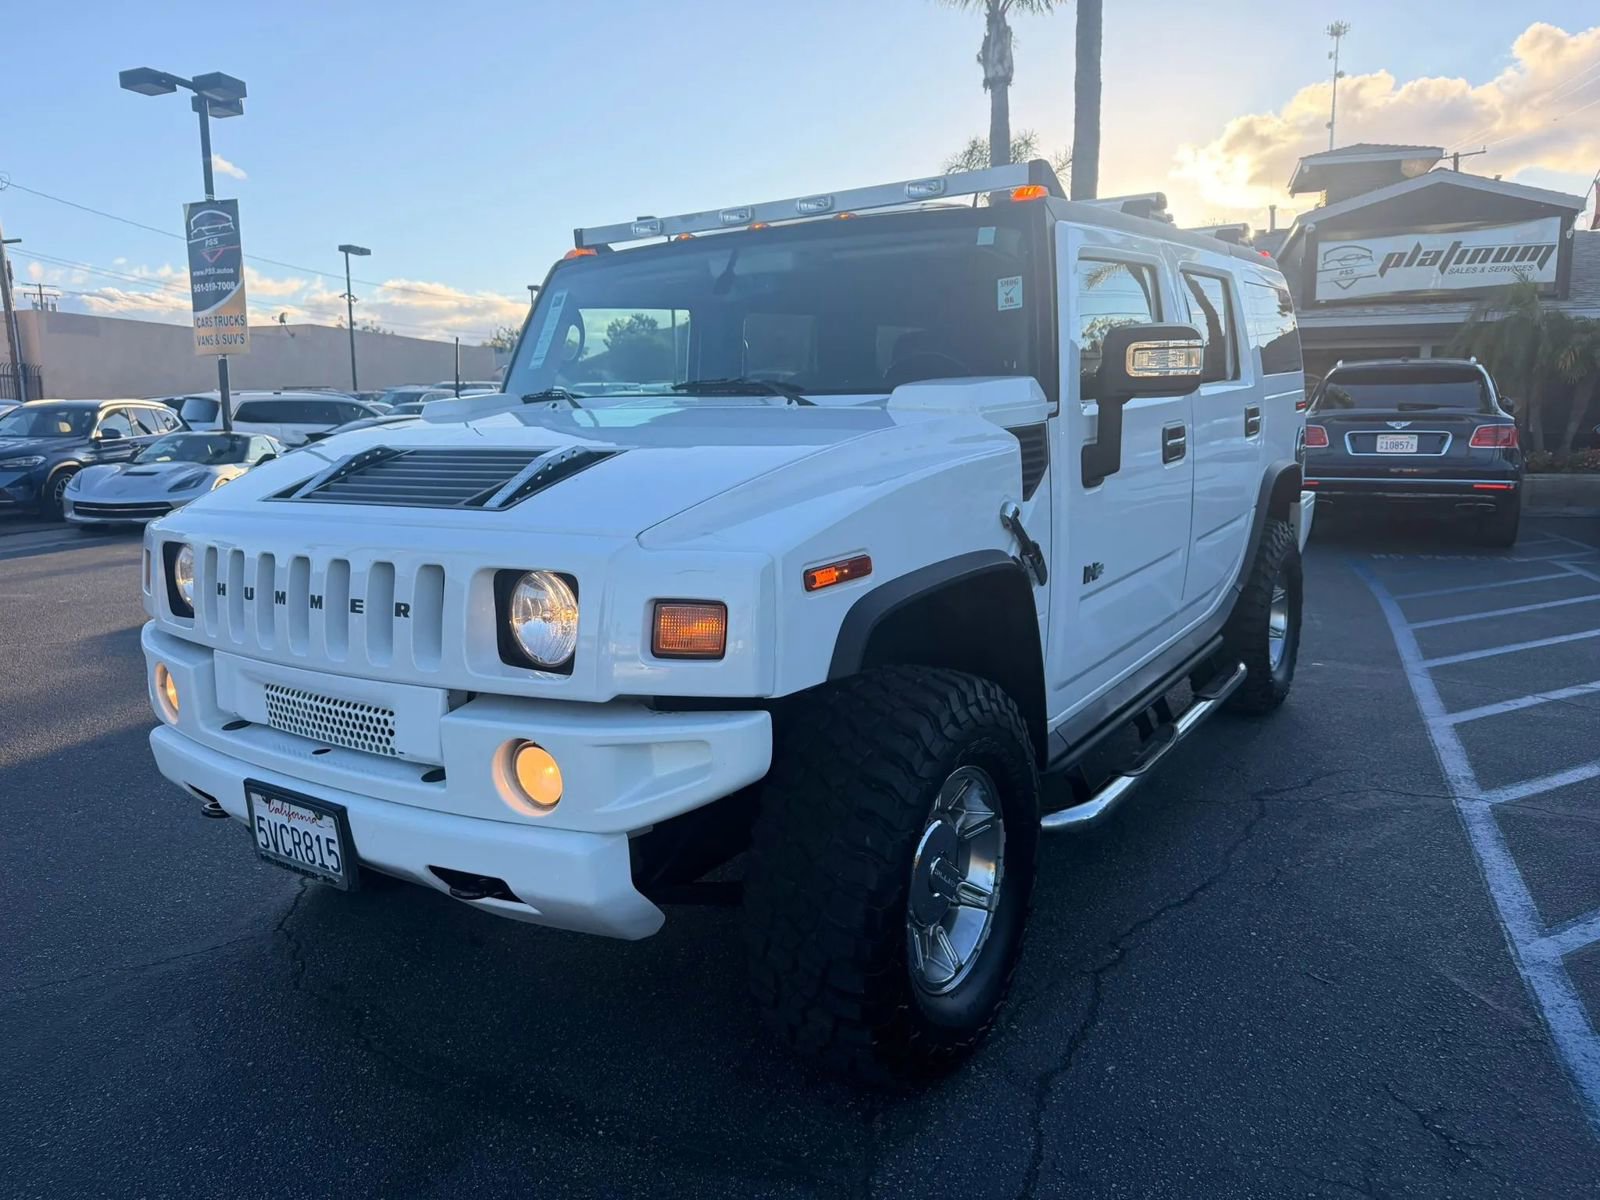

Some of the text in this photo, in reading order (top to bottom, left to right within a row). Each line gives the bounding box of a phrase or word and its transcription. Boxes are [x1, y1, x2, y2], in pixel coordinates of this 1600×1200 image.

[1448, 266, 1478, 275] SALES
[1488, 264, 1535, 273] SERVICES
[197, 314, 245, 328] CARS TRUCKS
[197, 333, 245, 346] VANS & SUV'S
[217, 582, 411, 618] HUMMER
[268, 799, 317, 824] California
[256, 815, 342, 873] 5VCR815
